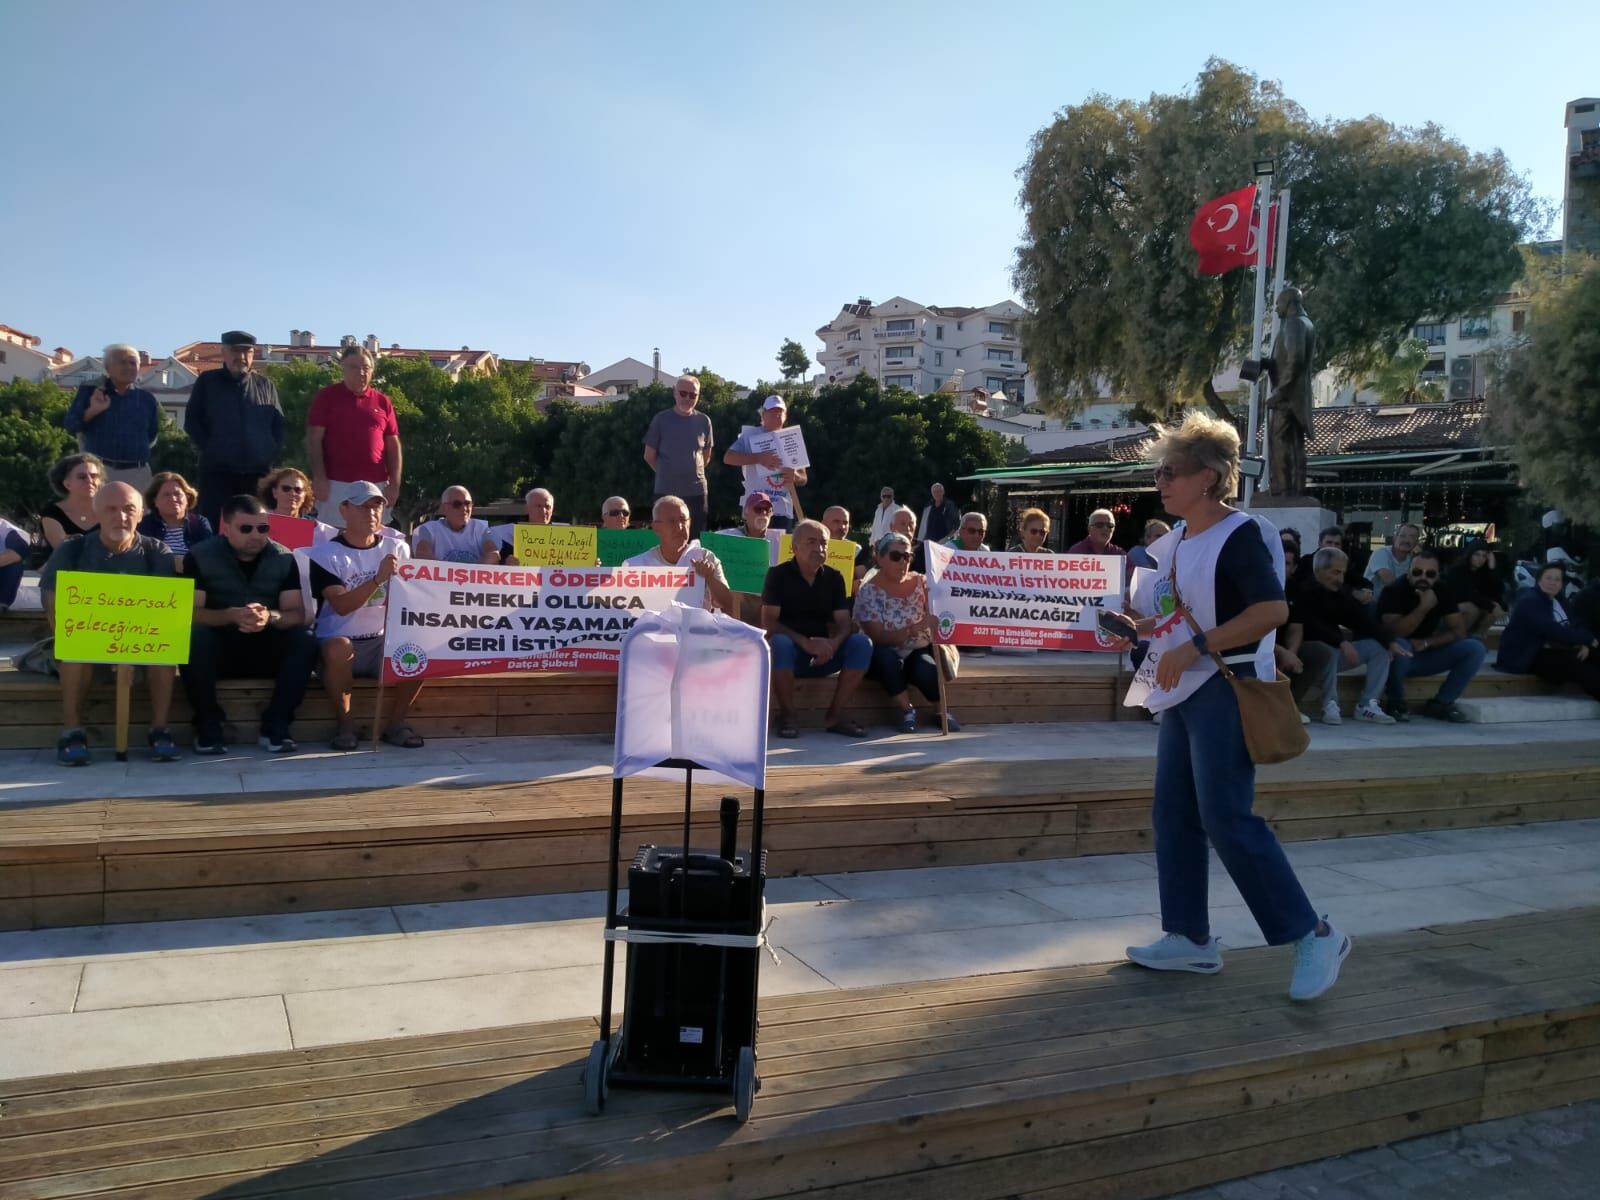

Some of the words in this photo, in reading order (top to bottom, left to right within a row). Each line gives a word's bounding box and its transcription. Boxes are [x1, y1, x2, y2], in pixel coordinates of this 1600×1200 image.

[521, 529, 545, 544] Para
[568, 531, 593, 551] Değil
[524, 548, 589, 560] ONURUMUZ
[1009, 556, 1053, 570] FİTRE
[1058, 557, 1105, 572] DEĞİL
[399, 564, 543, 586] ÇALIŞIRKEN
[550, 569, 695, 588] ÖDEDİĞİMİZİ
[942, 570, 1017, 587] HAKKIMIZI
[1020, 574, 1107, 590] İSTİYORUZ!
[66, 585, 93, 605] Biz
[450, 591, 538, 608] EMEKLİ
[545, 595, 645, 609] OLUNCA
[401, 607, 513, 630] İNSANCA
[969, 605, 1080, 623] KAZANACAĞIZ!
[973, 627, 989, 635] 2021
[990, 627, 1005, 636] Tüm
[447, 635, 505, 652] GERİ
[999, 636, 1019, 645] Datça
[1020, 637, 1044, 646] Şubesi
[507, 660, 539, 669] Datça
[542, 659, 578, 670] Şubesi
